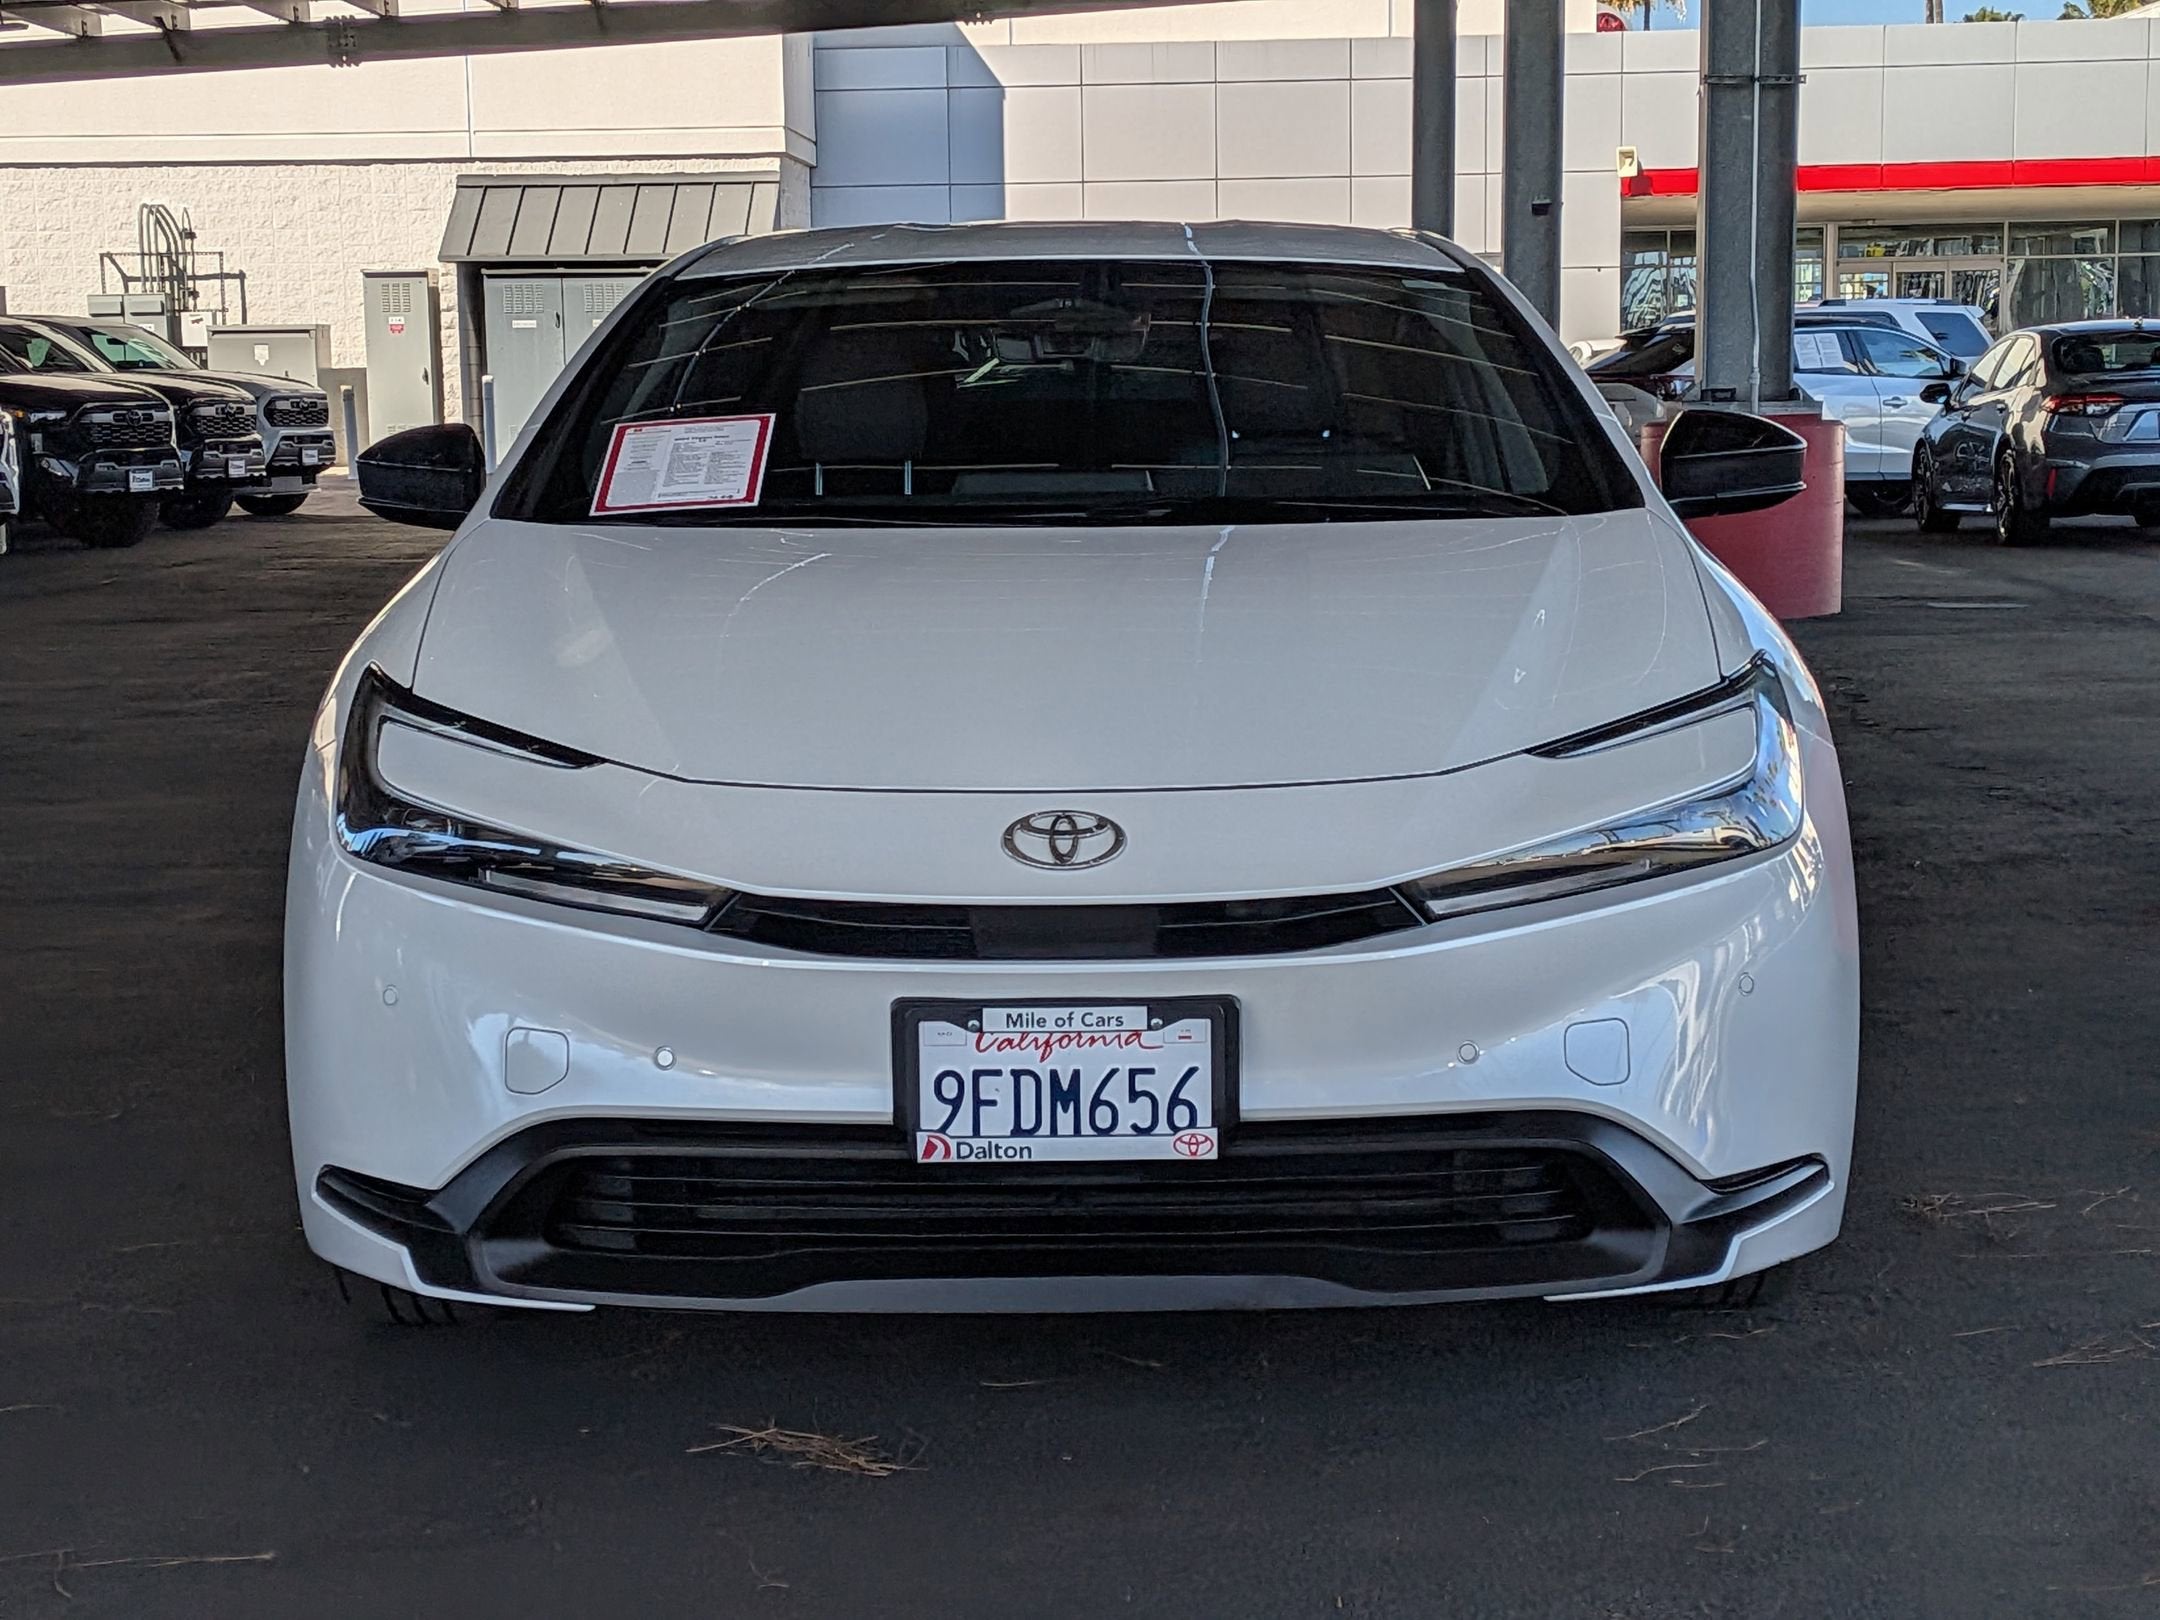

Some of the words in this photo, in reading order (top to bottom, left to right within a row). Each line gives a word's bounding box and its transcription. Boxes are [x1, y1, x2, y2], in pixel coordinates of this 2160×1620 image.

[1005, 1012, 1048, 1028] Mile
[1055, 1011, 1075, 1027] of
[1080, 1011, 1125, 1027] Cars
[975, 1031, 1163, 1063] California
[933, 1066, 1199, 1136] 9FDM656
[956, 1142, 1033, 1160] Dalton
